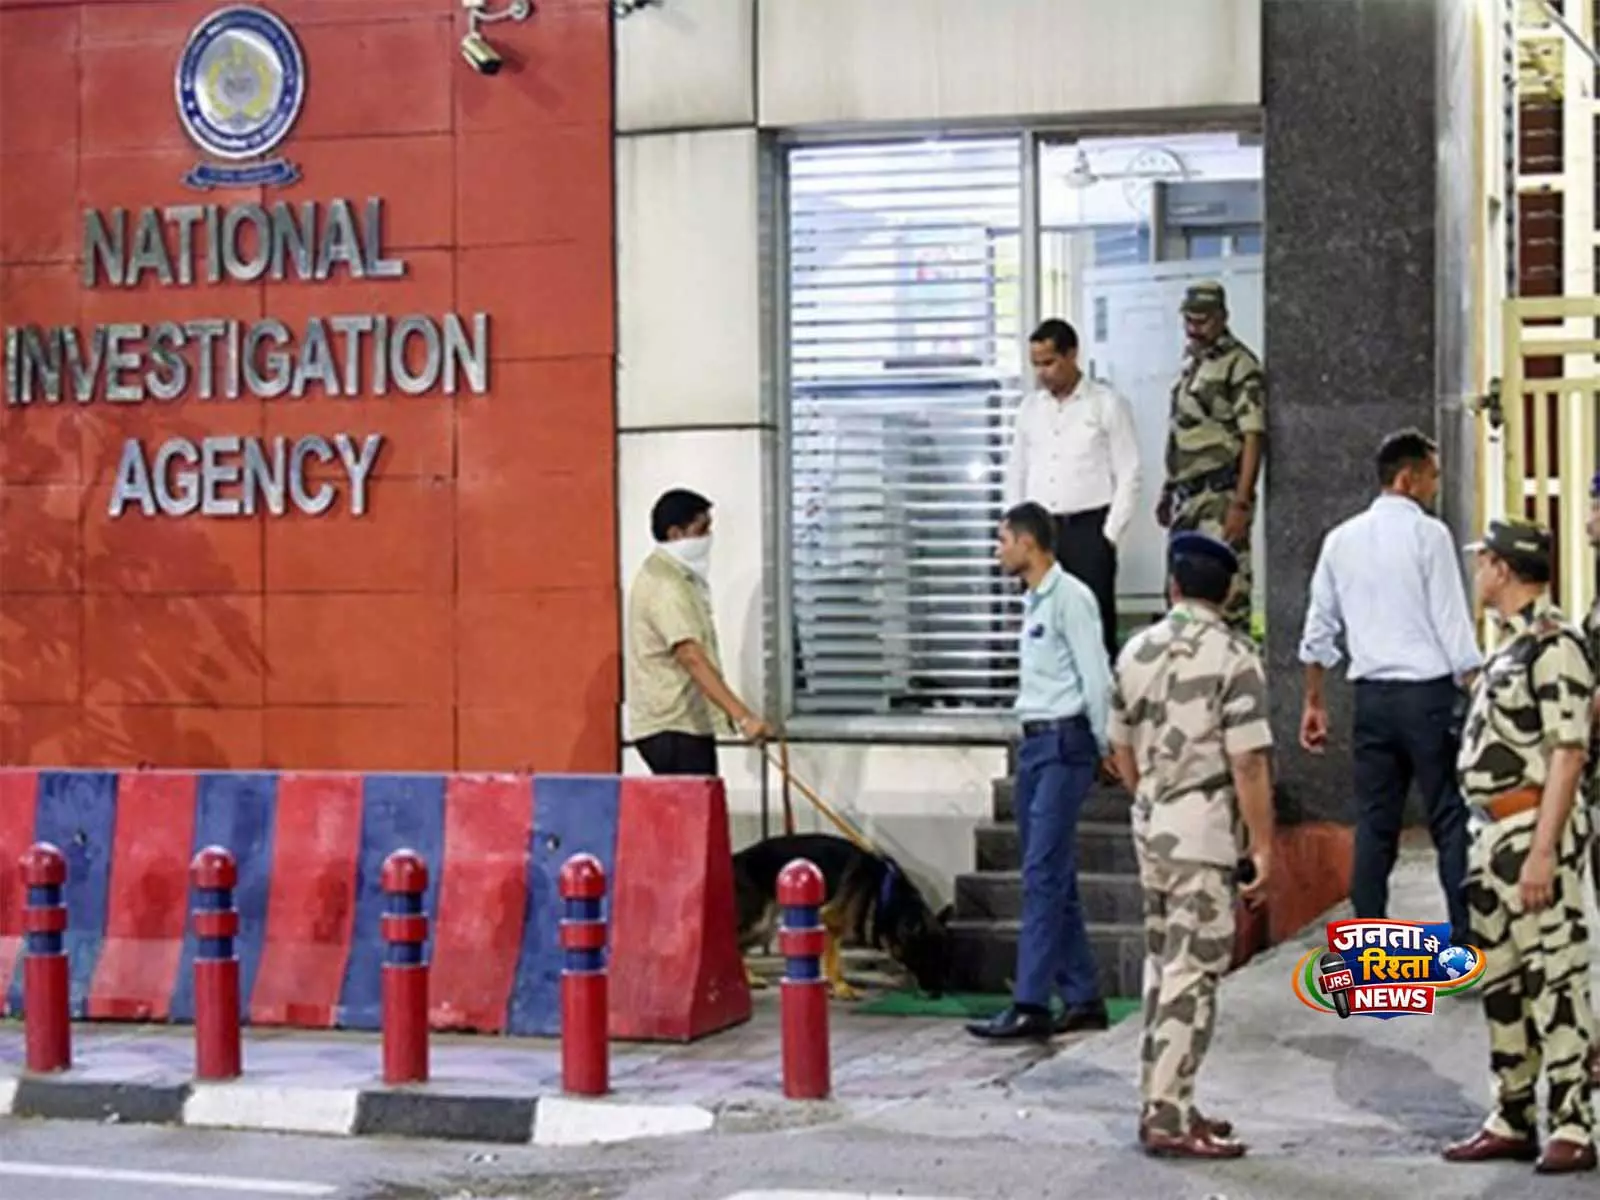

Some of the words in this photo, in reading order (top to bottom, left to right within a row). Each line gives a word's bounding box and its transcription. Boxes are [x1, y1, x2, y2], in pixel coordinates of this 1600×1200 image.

[83, 198, 405, 287] NATIONAL
[5, 313, 489, 404] INVESTIGATION
[108, 433, 384, 517] AGENCY
